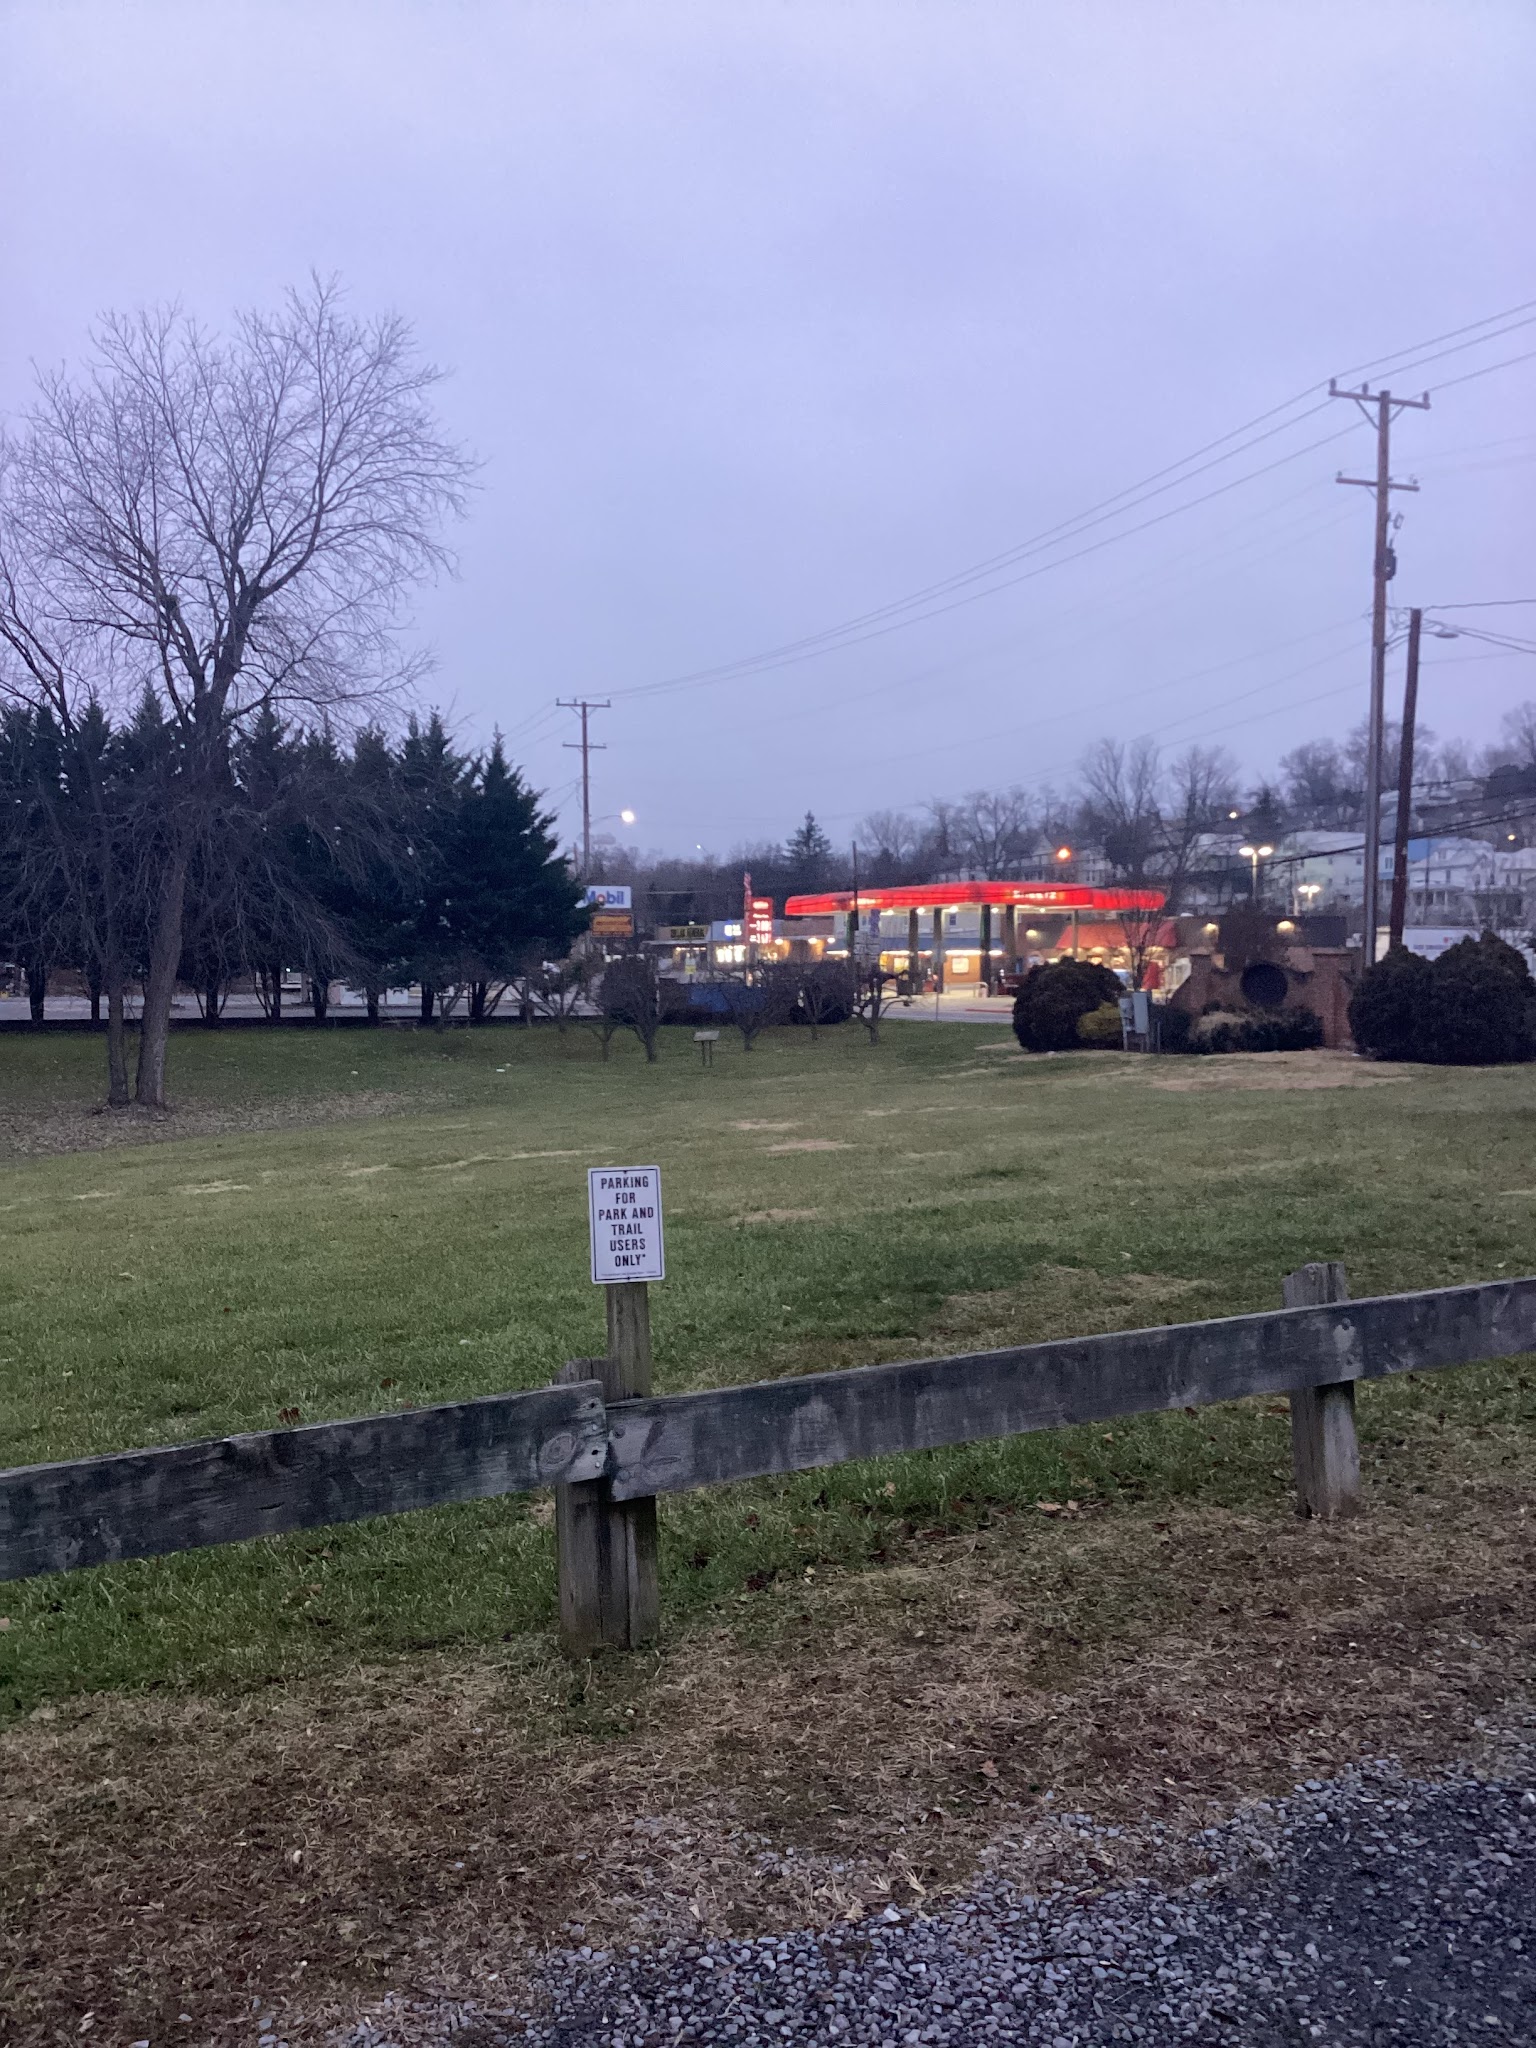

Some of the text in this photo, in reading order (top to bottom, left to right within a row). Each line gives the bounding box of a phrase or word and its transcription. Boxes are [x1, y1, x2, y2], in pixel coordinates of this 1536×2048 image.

[583, 890, 624, 905] Mobil
[600, 1176, 649, 1190] PARKING
[615, 1192, 636, 1205] FOR
[598, 1206, 654, 1221] PARK AND
[611, 1223, 643, 1236] TRAIL
[609, 1238, 646, 1252] USERS
